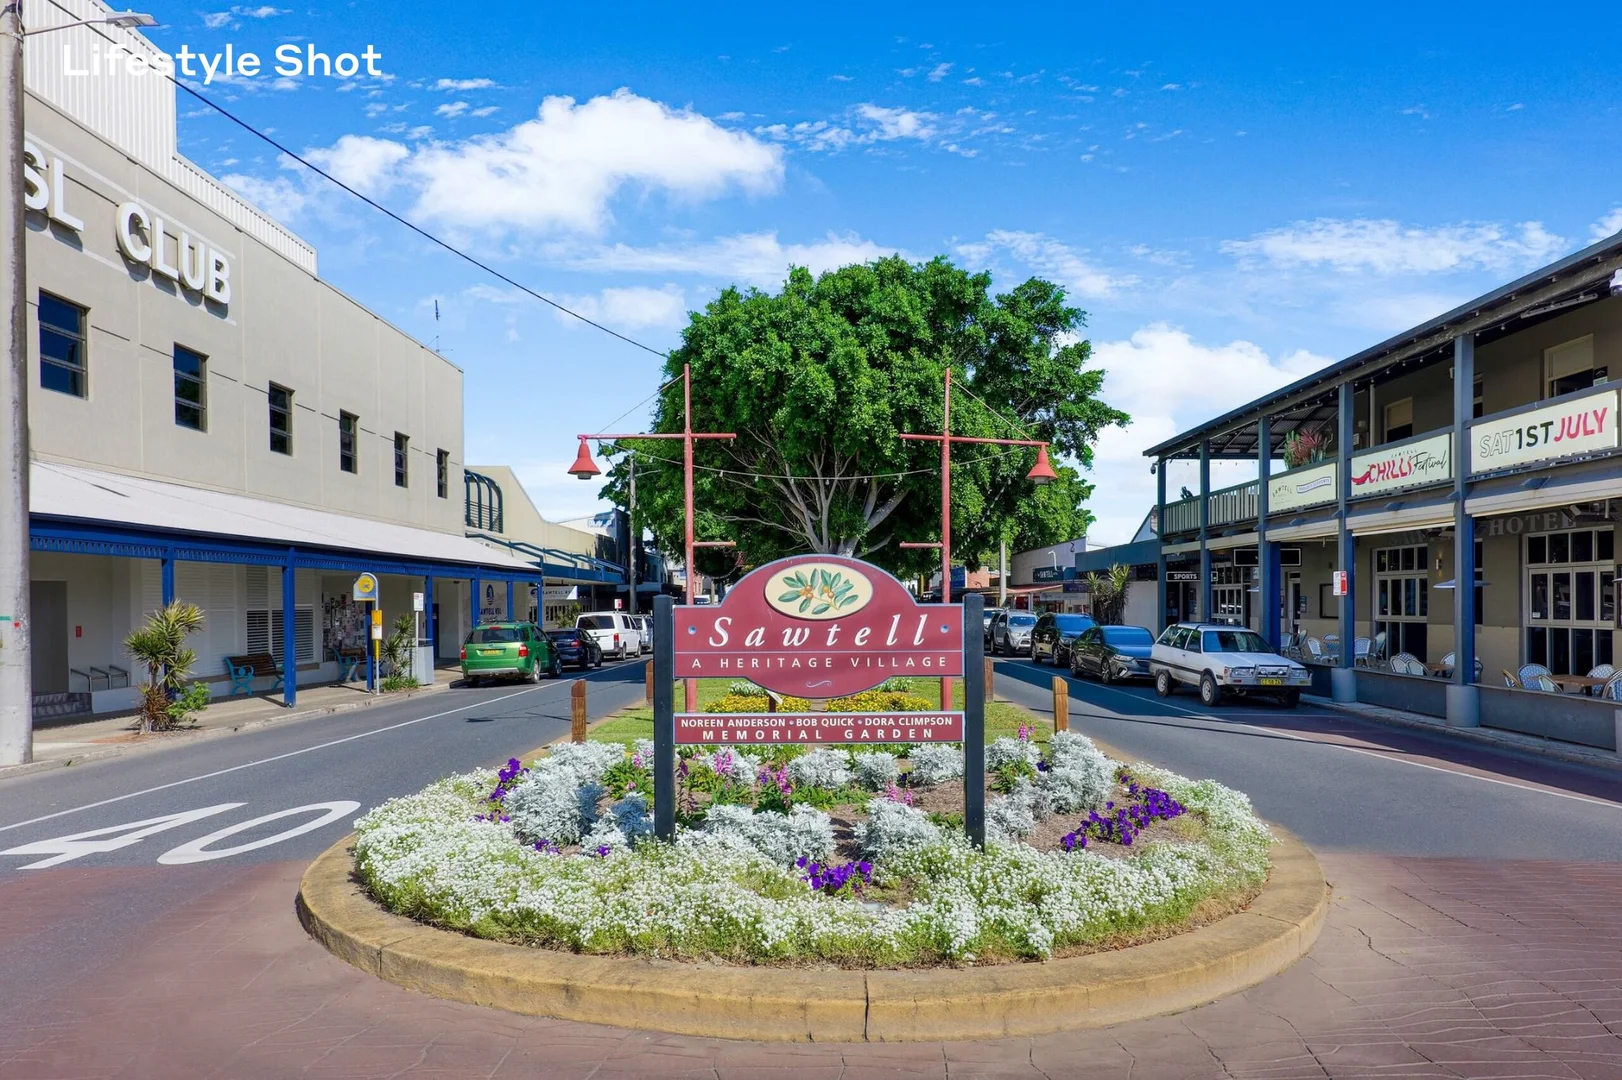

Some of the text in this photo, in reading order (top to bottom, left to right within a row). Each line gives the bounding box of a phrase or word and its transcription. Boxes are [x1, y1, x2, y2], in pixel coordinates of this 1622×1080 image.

[116, 202, 231, 304] CLUB
[1411, 450, 1447, 475] Festival
[709, 614, 927, 647] Sawtell
[692, 656, 947, 669] A HERITAGE VILLAGE
[681, 716, 953, 728] NOREEN ANDERSON BOB QUICK DORA CLIMPSON
[702, 728, 933, 740] MEMORIAL GARDEN
